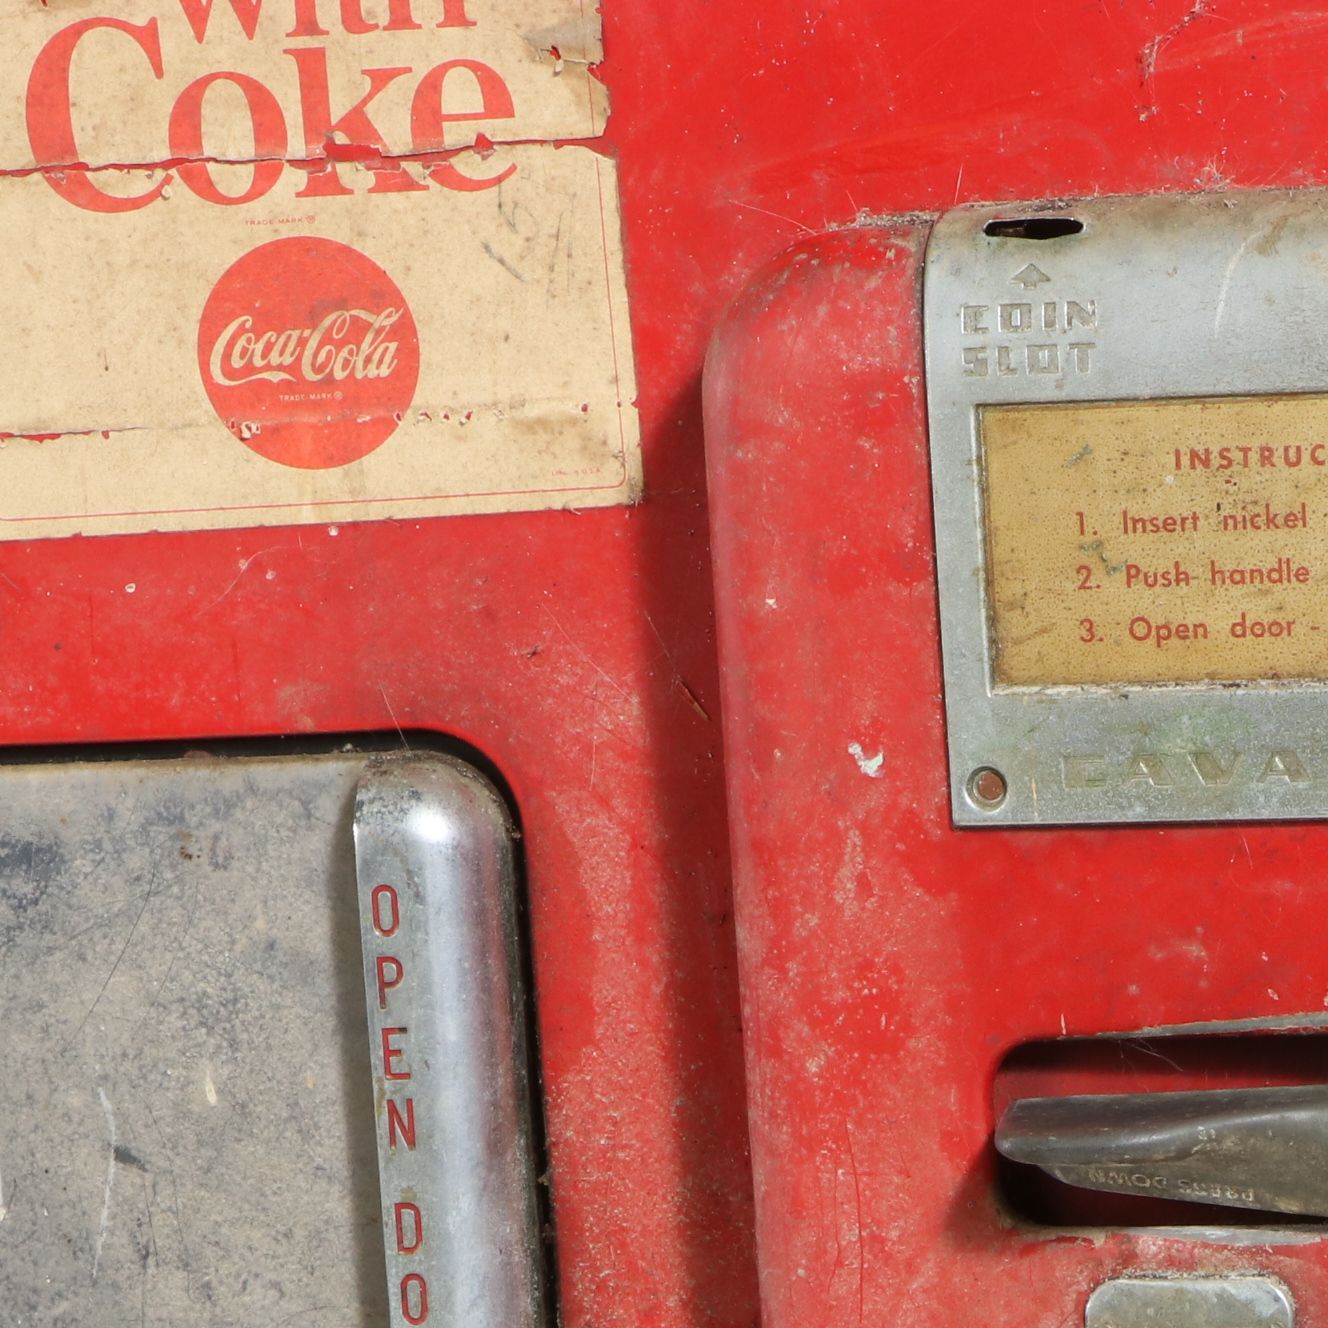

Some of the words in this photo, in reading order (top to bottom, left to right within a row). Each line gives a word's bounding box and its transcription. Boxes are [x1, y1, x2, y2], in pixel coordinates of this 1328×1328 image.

[24, 16, 517, 214] Coke
[960, 300, 1099, 335] COIN
[209, 306, 404, 387] Coca-Cola
[961, 342, 1097, 378] SLOT
[1075, 510, 1099, 537] 1.
[1121, 506, 1200, 535] Insert
[1222, 501, 1308, 532] nickel
[1075, 564, 1102, 591] 2.
[1124, 560, 1191, 589] Push
[1209, 557, 1310, 587] handle
[1078, 617, 1105, 644] 3.
[1128, 615, 1209, 649] Open
[1229, 611, 1296, 639] door
[371, 883, 419, 1152] OPEN
[1088, 1167, 1168, 1189] DOWN
